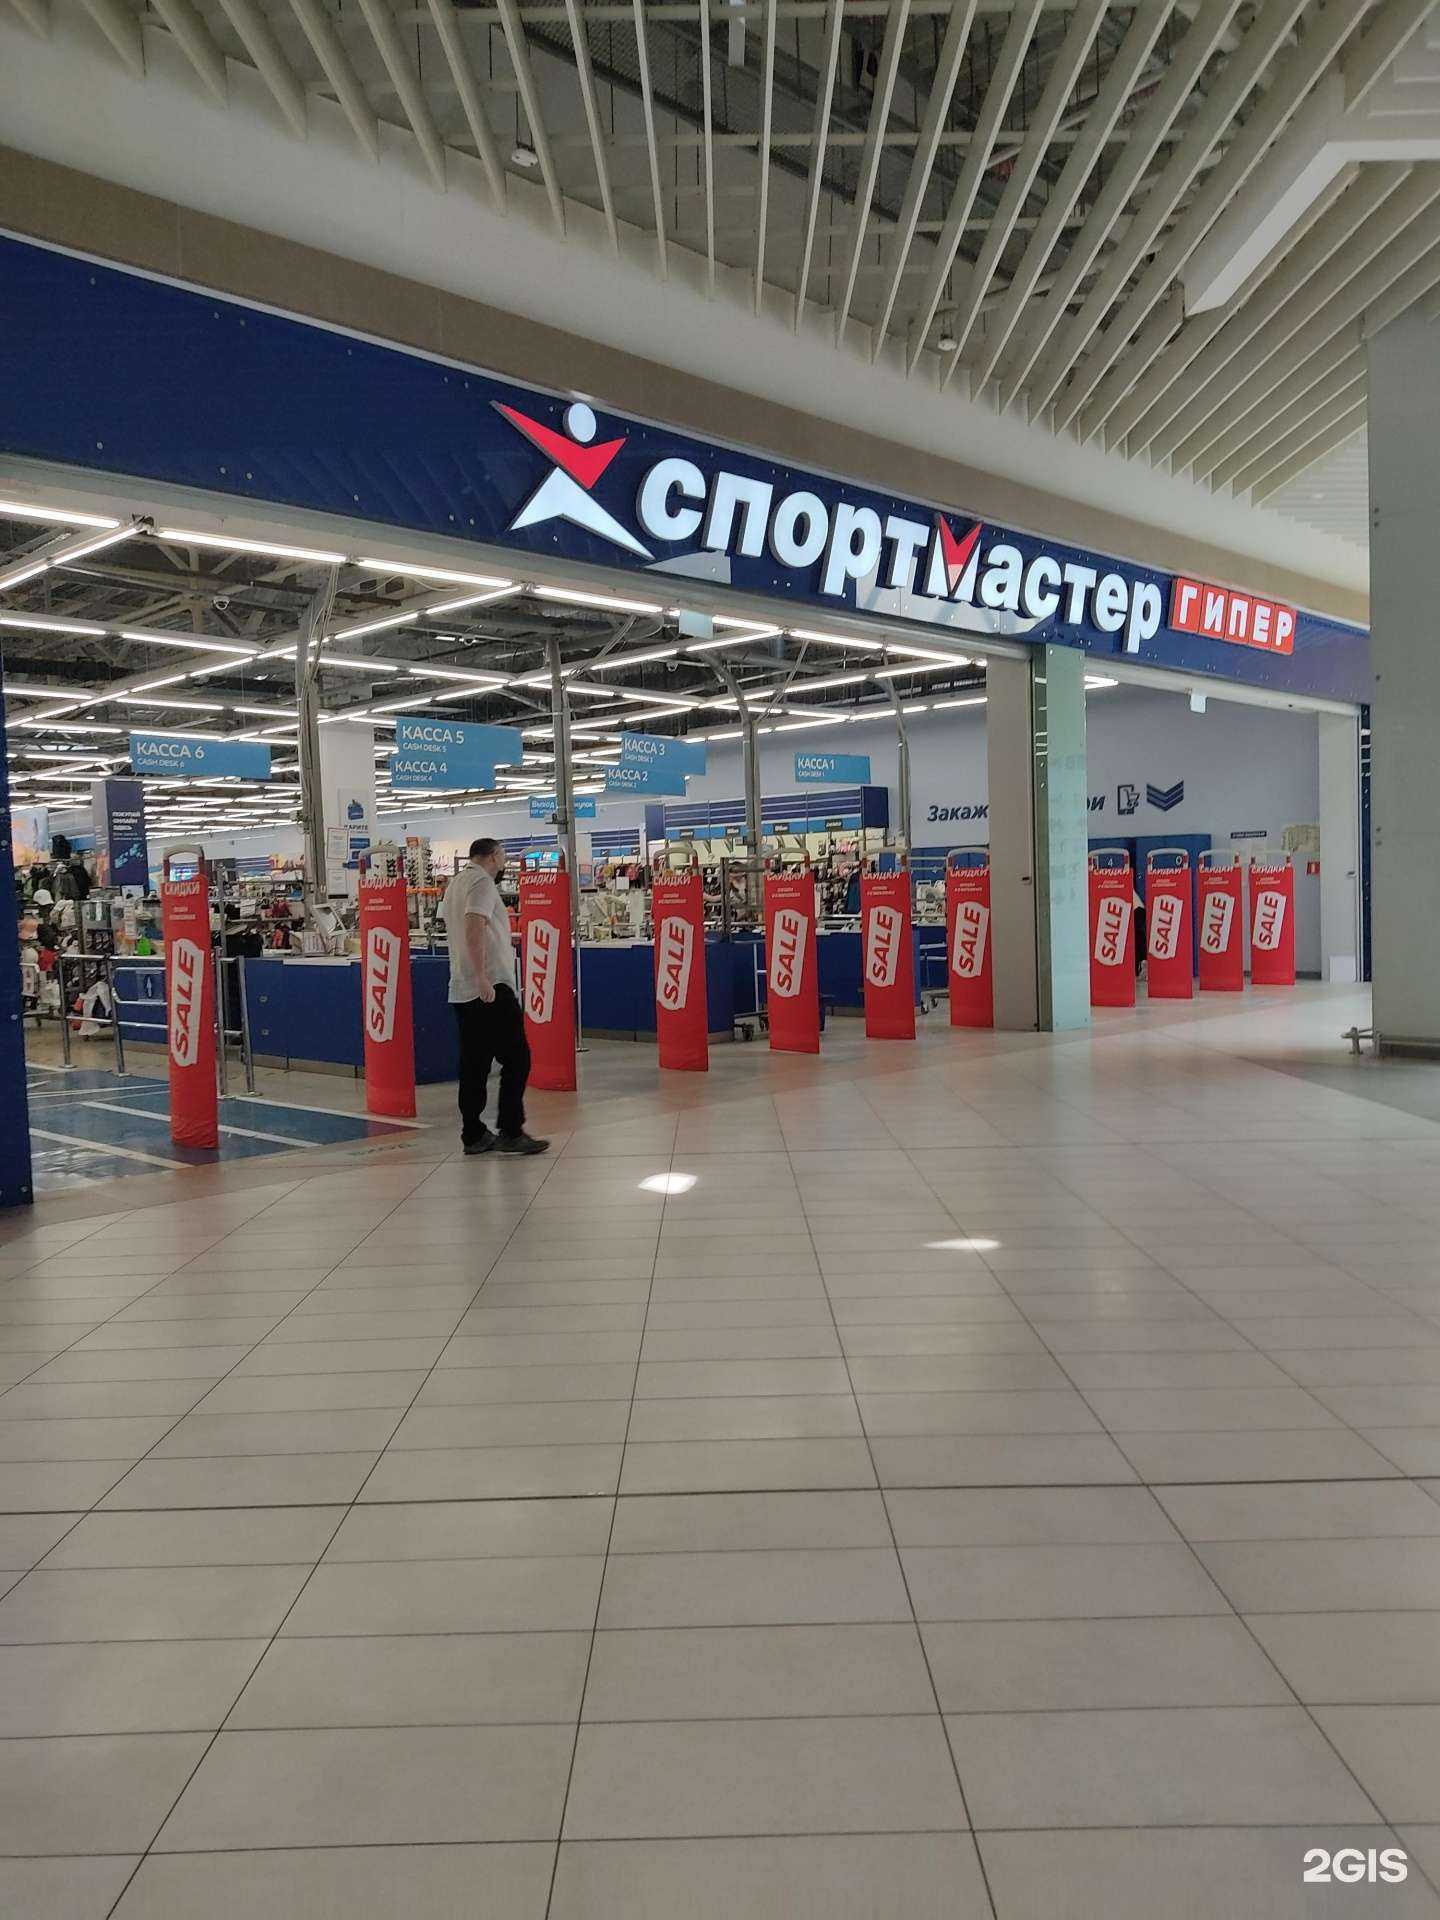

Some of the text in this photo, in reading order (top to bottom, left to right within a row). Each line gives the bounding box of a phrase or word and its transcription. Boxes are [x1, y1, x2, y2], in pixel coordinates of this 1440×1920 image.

[1178, 584, 1293, 647] ГИПЕР
[136, 742, 205, 759] КАССА 6
[402, 725, 464, 744] КАССА 5
[402, 742, 422, 750] CASH
[424, 744, 442, 752] DESK
[624, 738, 665, 756] КАССА 3
[137, 758, 158, 766] CASH
[395, 761, 448, 774] КАССА 4
[608, 768, 648, 782] КАССА 2
[797, 758, 835, 770] КАССА 1
[927, 805, 990, 822] Закаж
[872, 911, 893, 983] SALE
[958, 906, 981, 973] SALE
[1101, 901, 1123, 961] SALE
[1155, 899, 1175, 955] SALE
[1207, 895, 1227, 949] SALE
[1259, 895, 1278, 945] SALE
[531, 926, 550, 1017] SALE
[664, 921, 686, 1005] SALE
[777, 914, 798, 993] SALE
[176, 945, 194, 1060] SALE
[371, 934, 390, 1034] SALE
